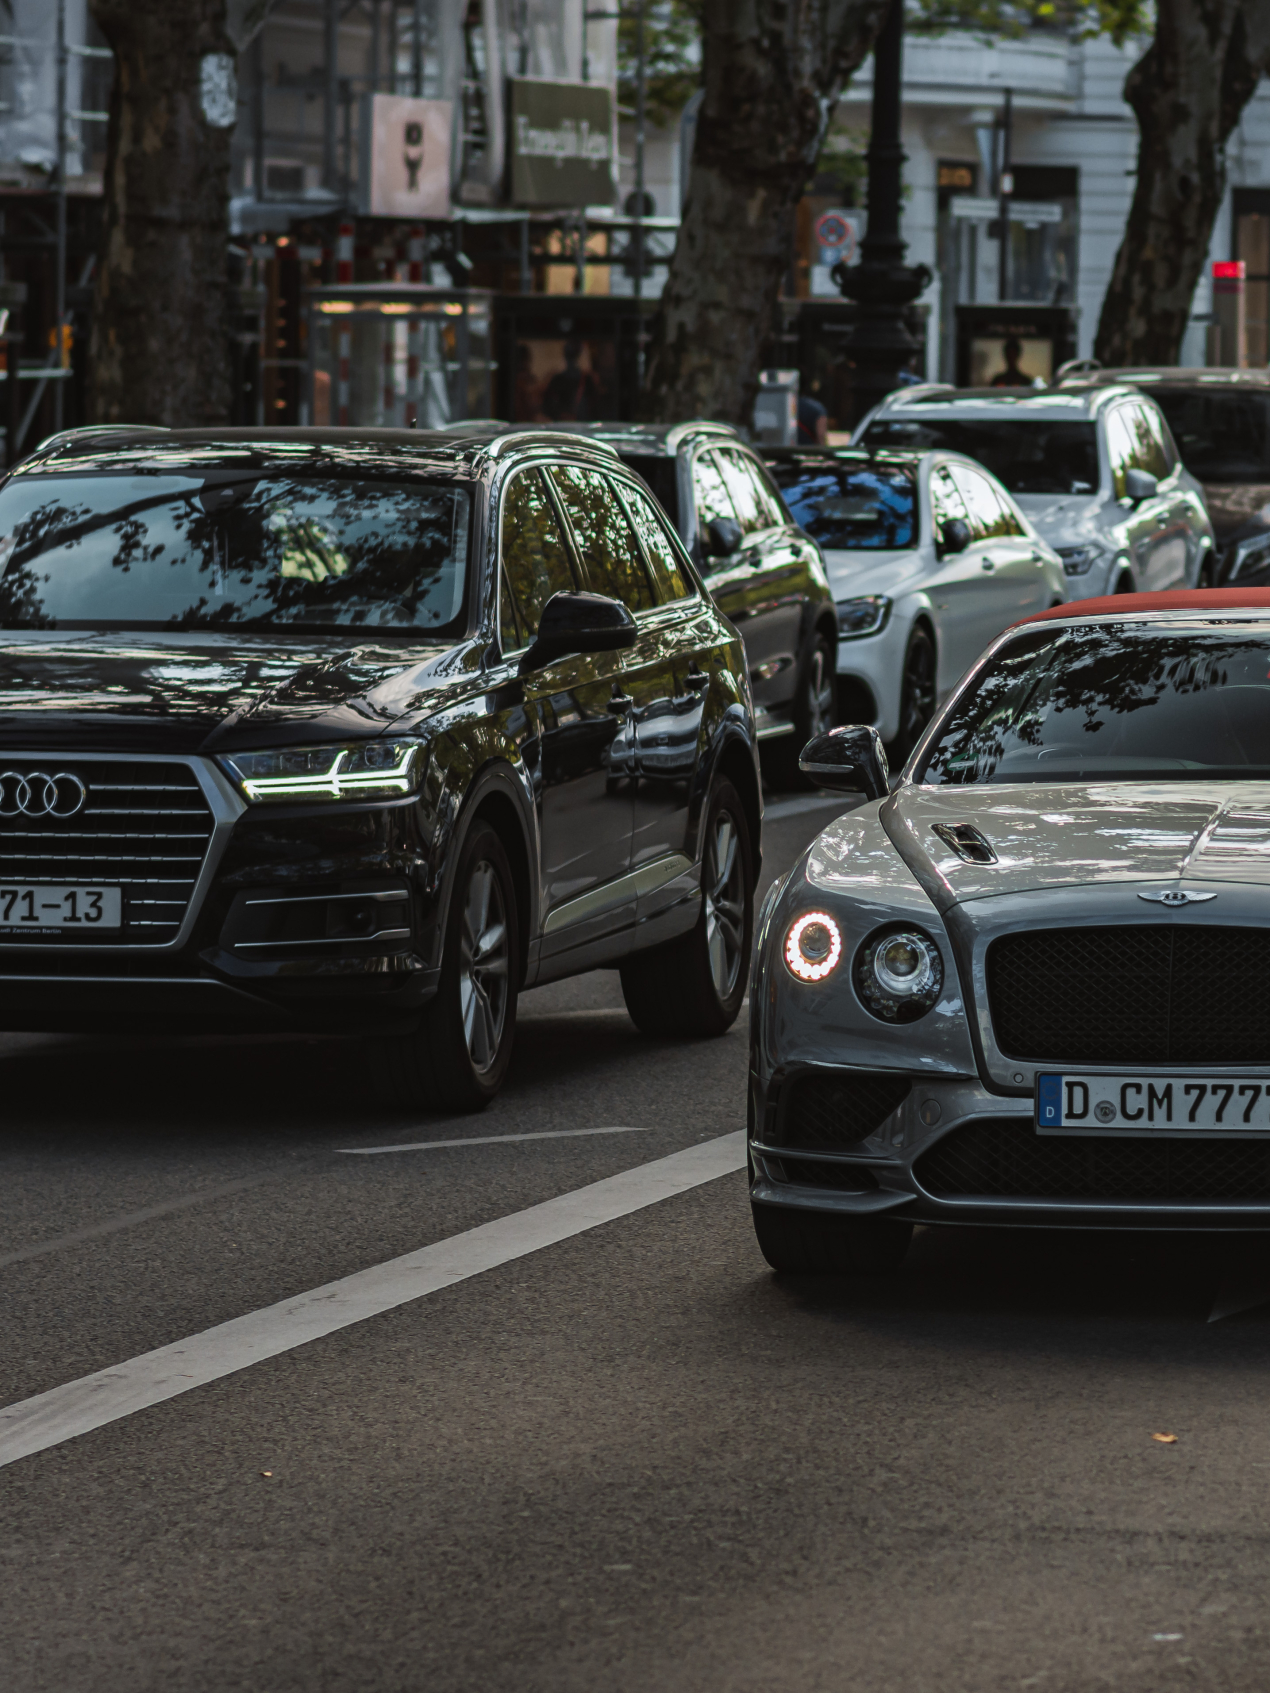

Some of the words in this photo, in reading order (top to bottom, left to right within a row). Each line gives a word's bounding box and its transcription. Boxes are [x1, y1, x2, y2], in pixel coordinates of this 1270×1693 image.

[1046, 1107, 1055, 1118] D
[1064, 1081, 1089, 1119] D
[1120, 1082, 1173, 1122] CM
